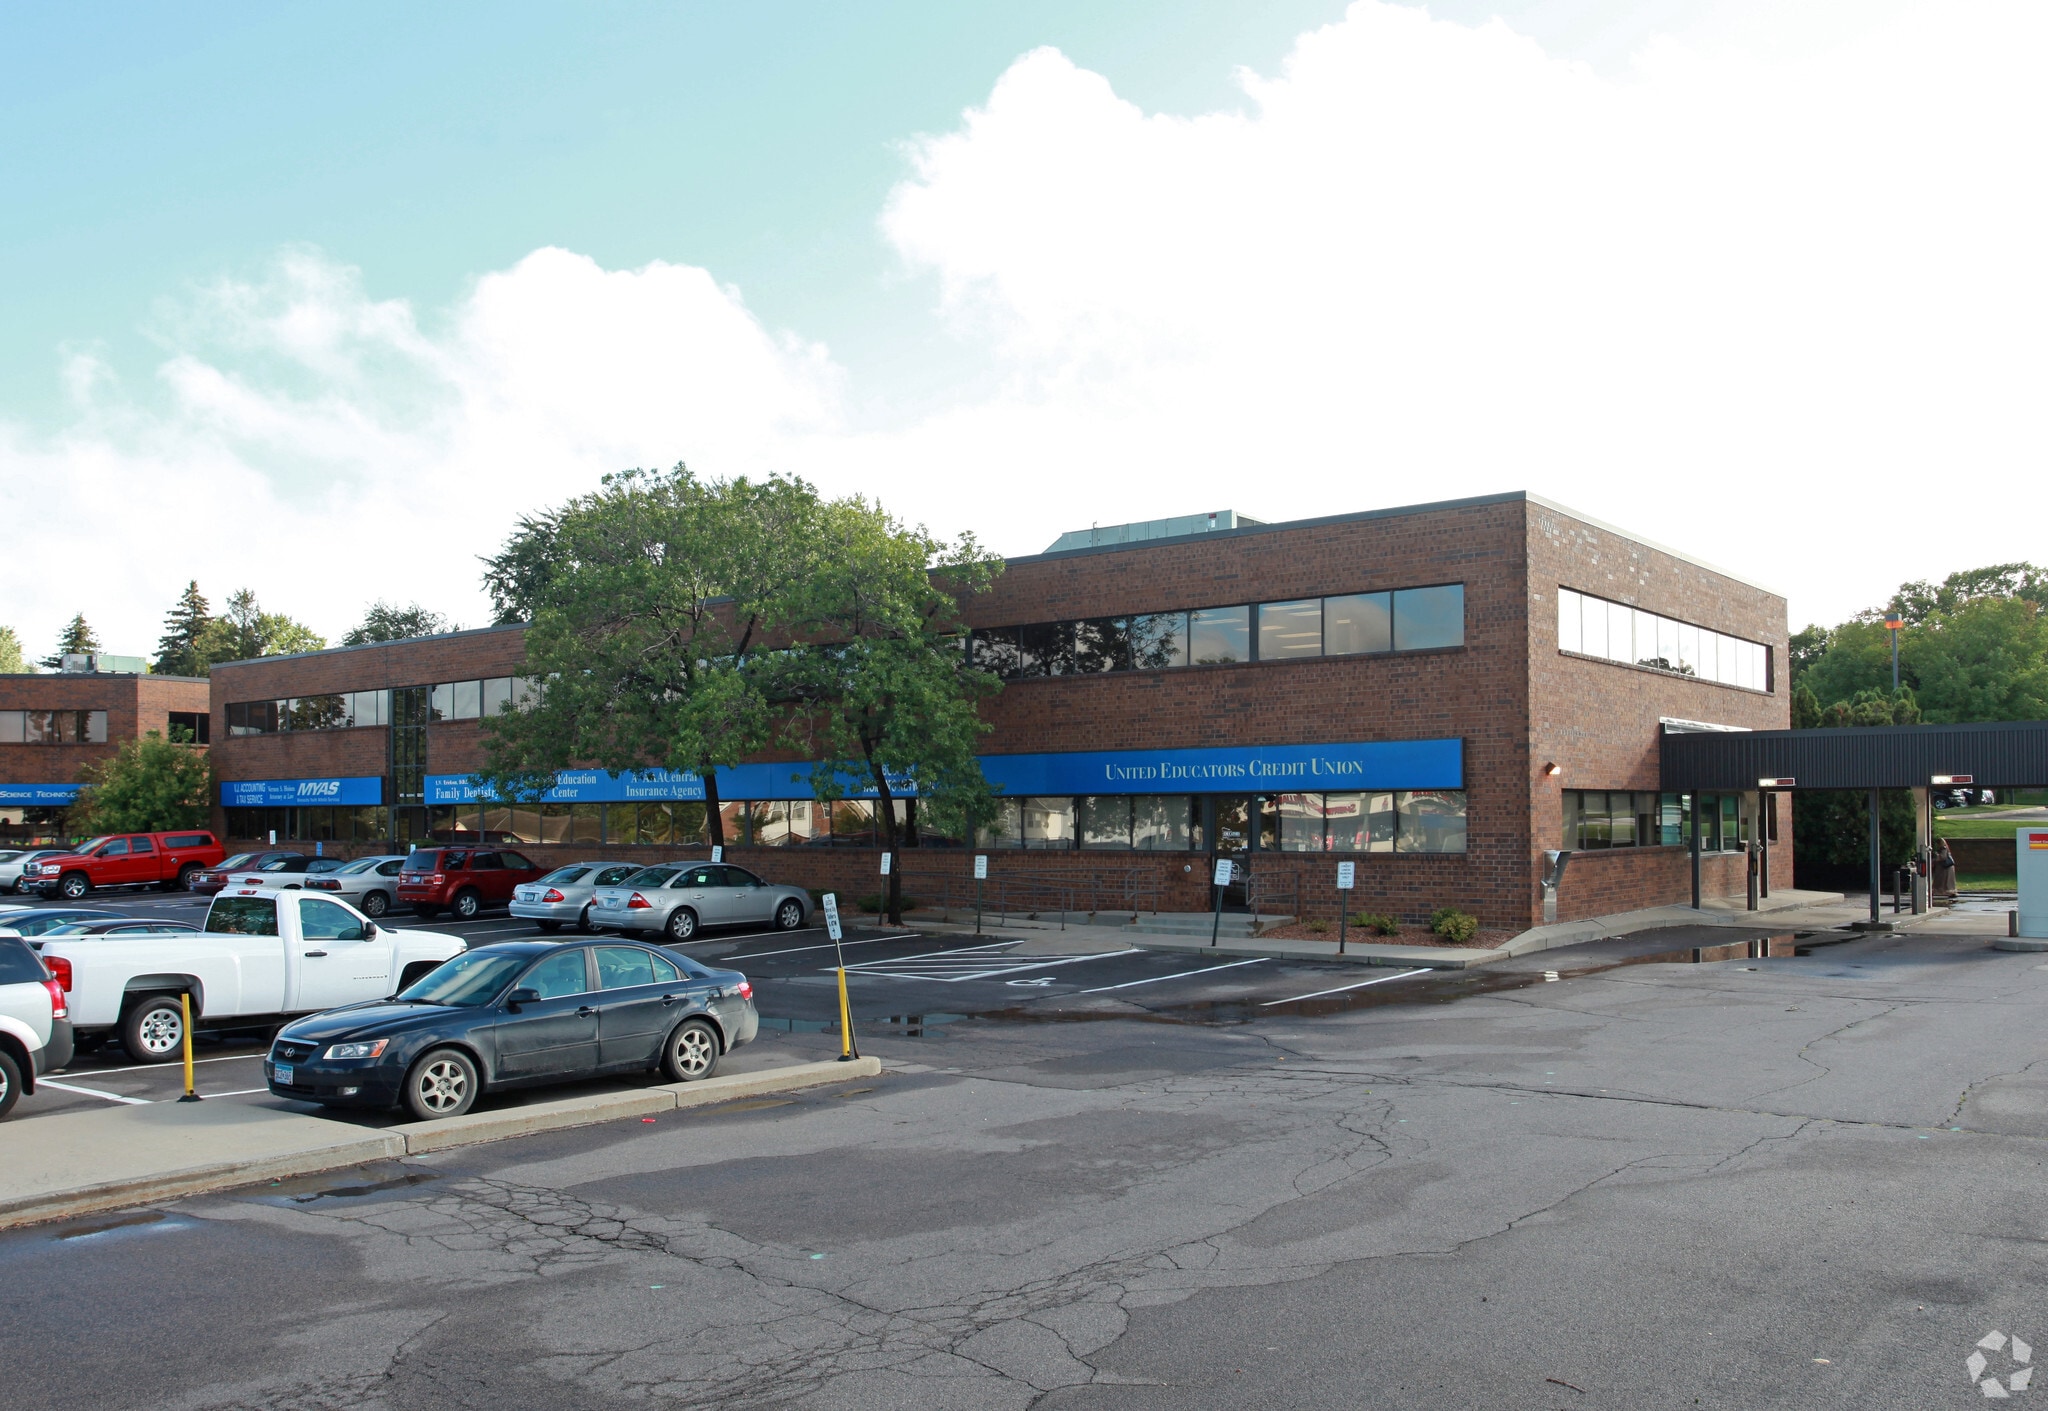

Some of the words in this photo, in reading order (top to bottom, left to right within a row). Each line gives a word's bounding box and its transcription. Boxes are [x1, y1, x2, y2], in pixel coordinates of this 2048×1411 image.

[1105, 763, 1157, 780] UNITED
[1160, 762, 1246, 779] EDUCATORS
[1249, 759, 1307, 777] CREDIT
[1311, 757, 1363, 776] UNION
[557, 773, 597, 785] Education
[297, 781, 341, 796] MYAS
[435, 787, 461, 800] Family
[552, 786, 579, 798] Center
[626, 785, 668, 797] Insurance
[670, 785, 703, 799] Agency
